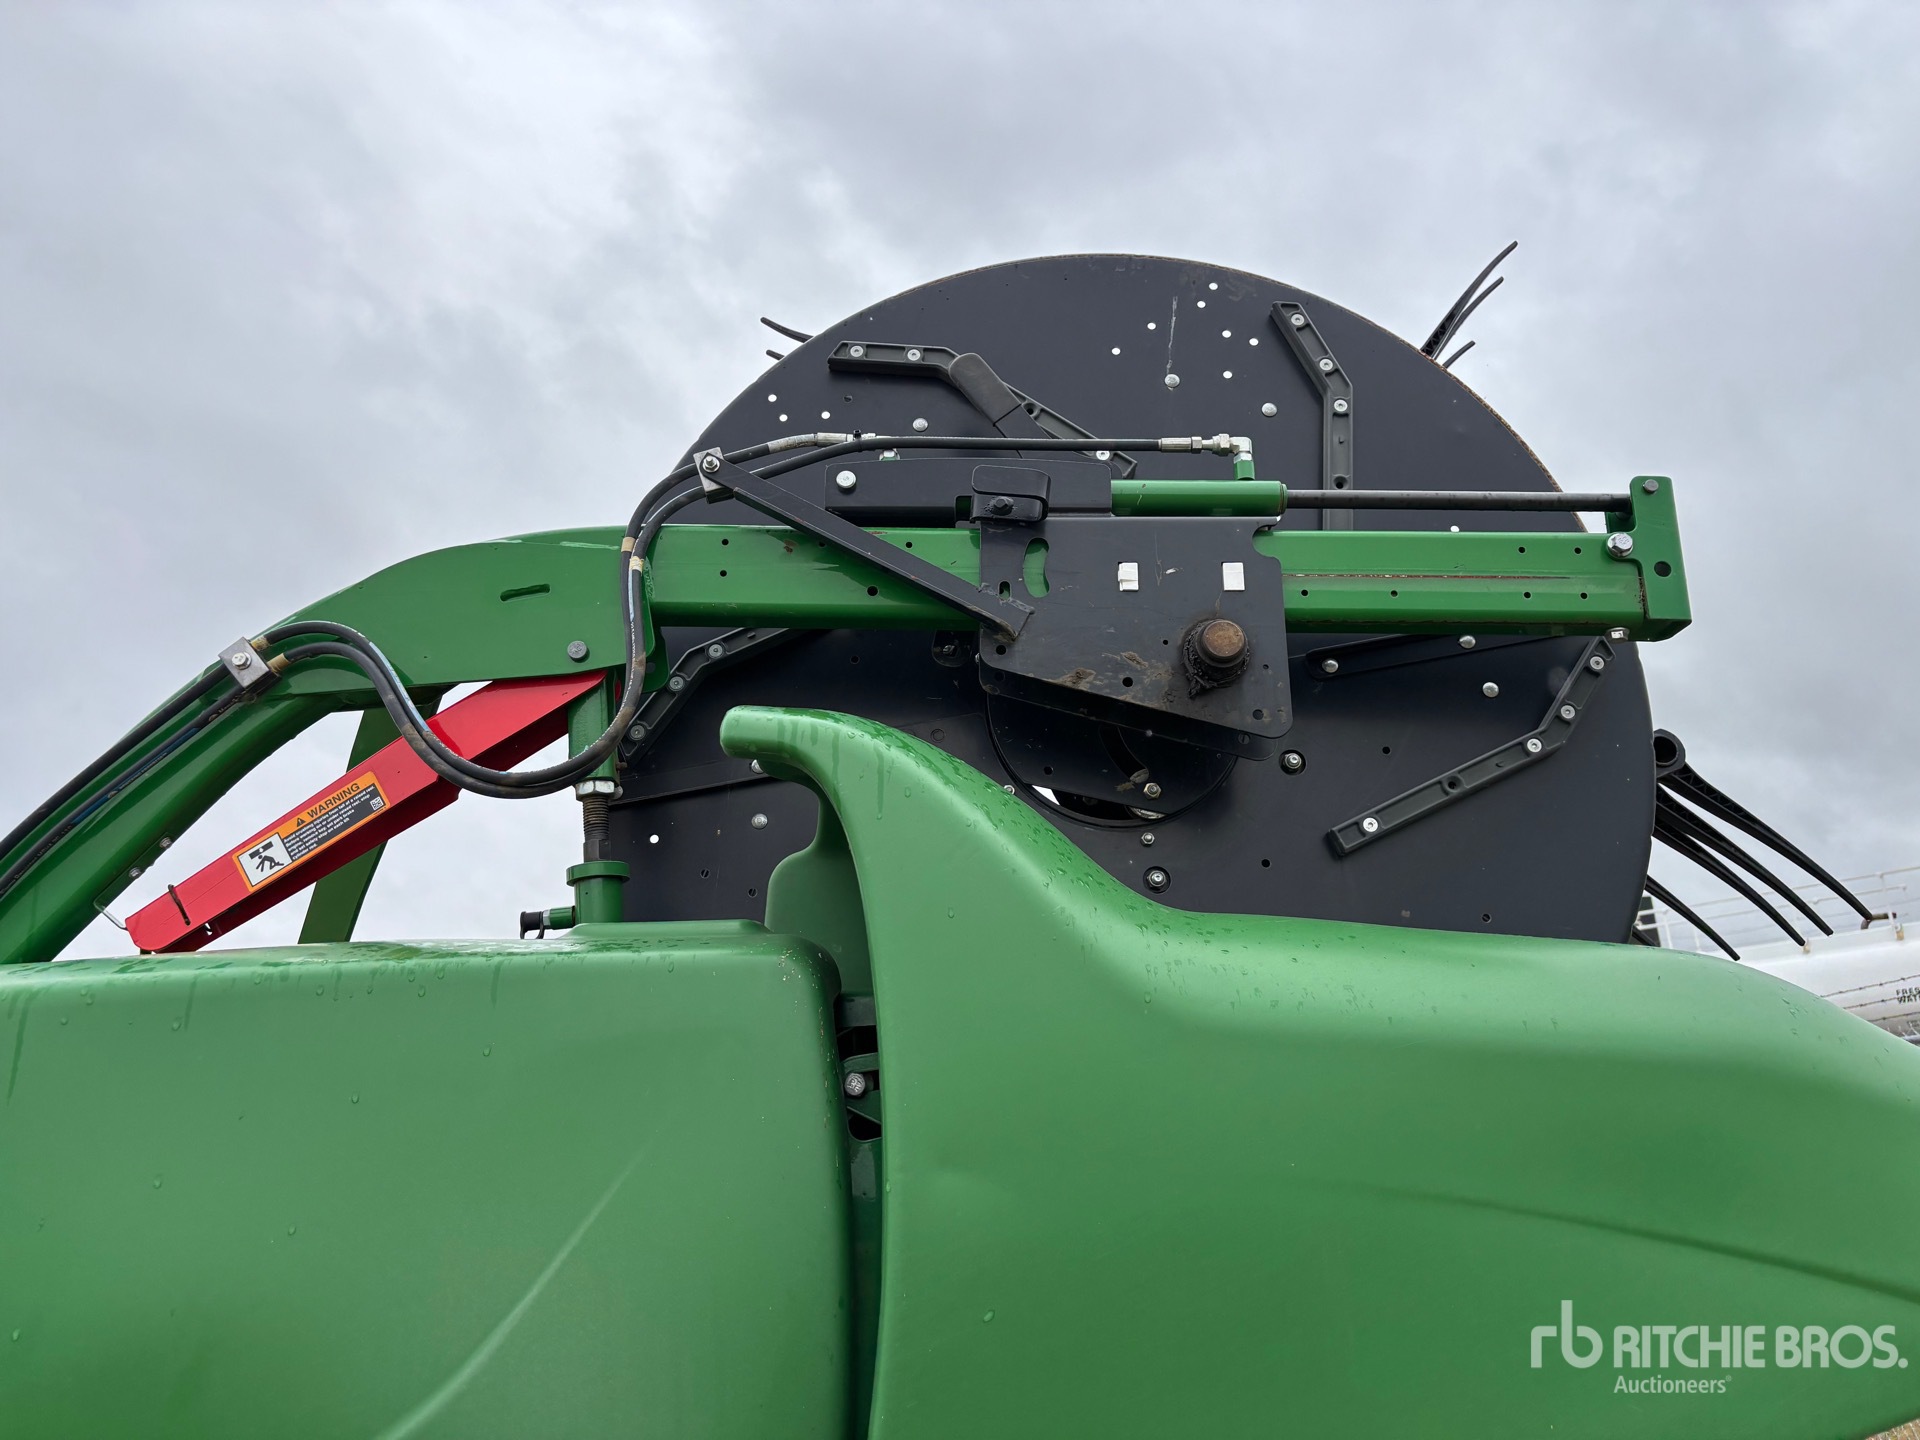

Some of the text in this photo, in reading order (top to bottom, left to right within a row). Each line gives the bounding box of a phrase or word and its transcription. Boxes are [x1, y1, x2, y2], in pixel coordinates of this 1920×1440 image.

[307, 782, 361, 818] WARNING
[284, 834, 295, 843] Avoid
[296, 823, 314, 836] crushing
[314, 814, 328, 825] injuries
[353, 791, 366, 800] raised
[286, 837, 299, 847] Before
[300, 827, 316, 839] working
[327, 813, 338, 822] under
[339, 805, 352, 814] raised
[303, 832, 318, 842] remove
[343, 809, 354, 818] brake
[293, 849, 309, 860] cylinder
[306, 837, 318, 847] safety
[318, 831, 328, 839] stop
[1897, 994, 1920, 1004] WAT
